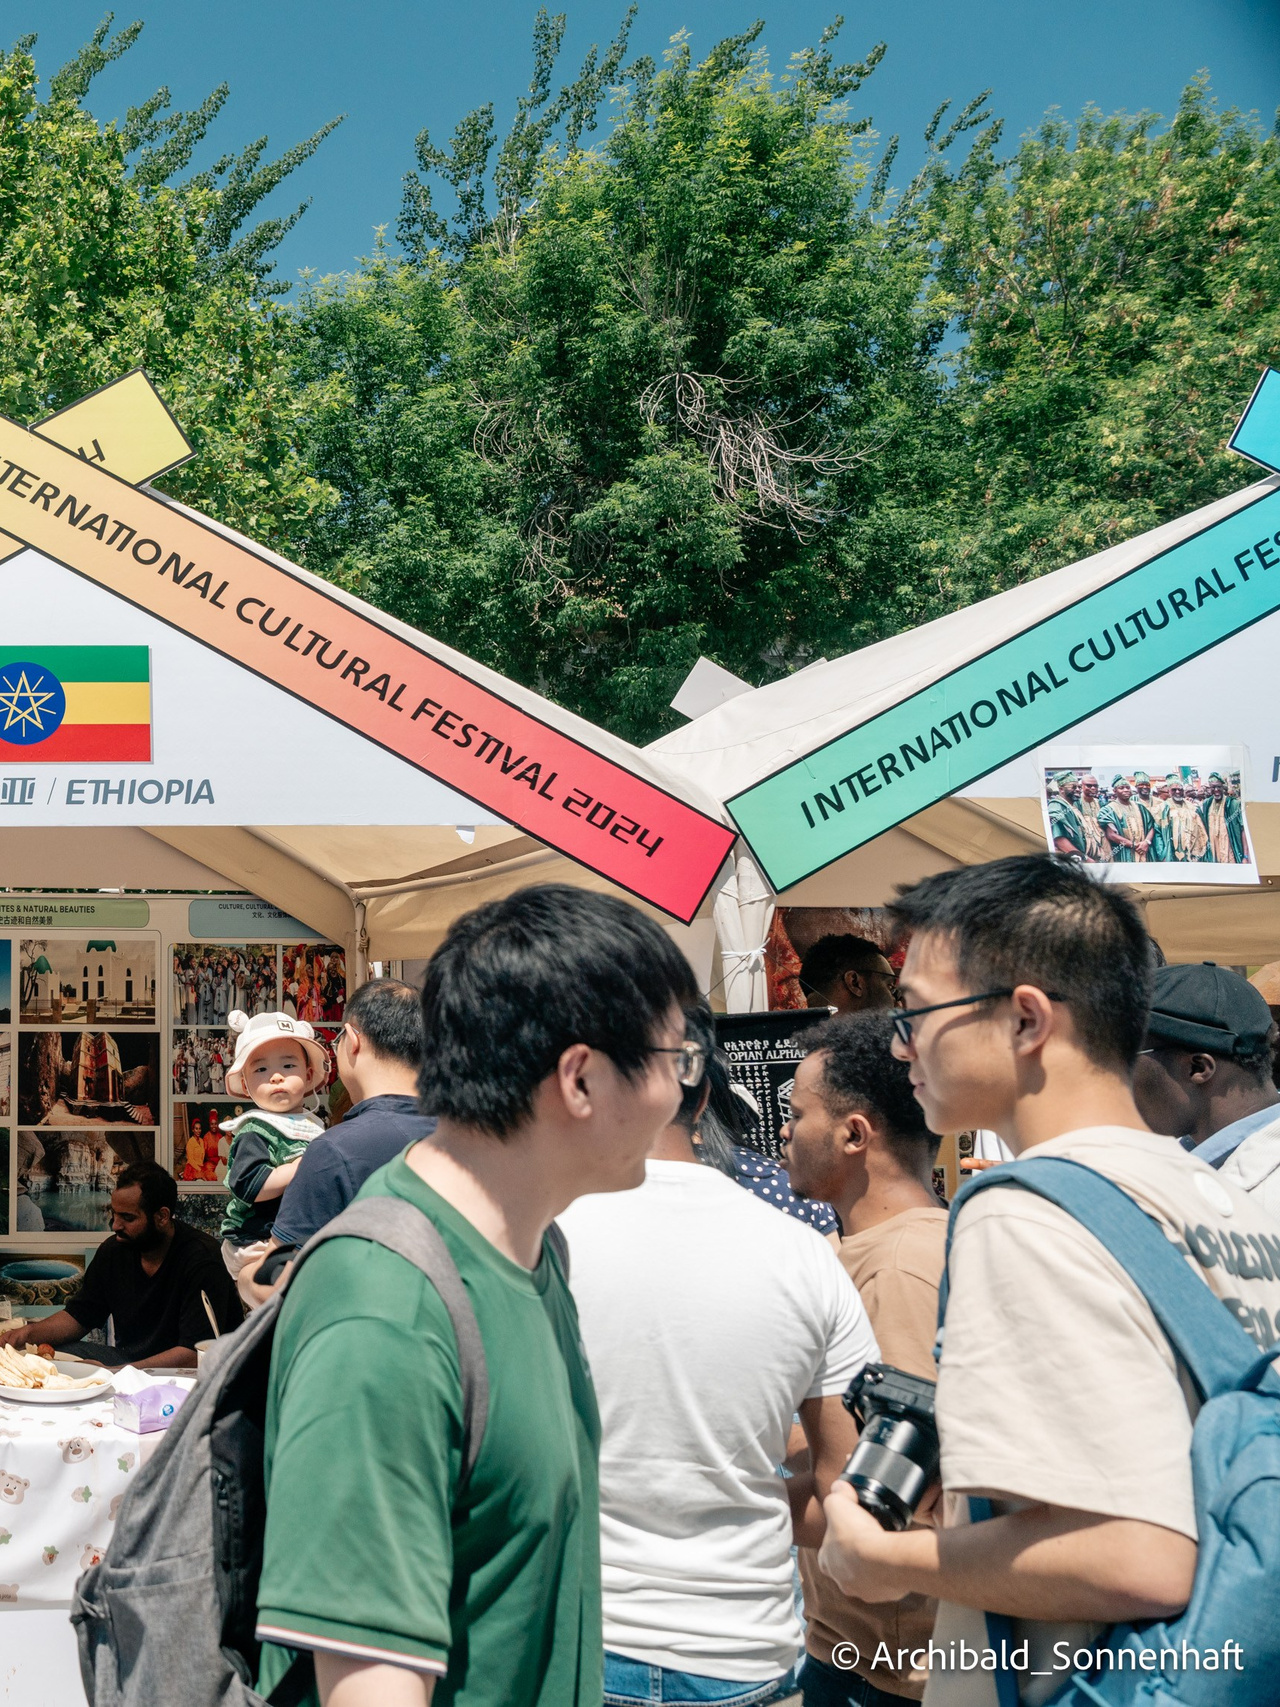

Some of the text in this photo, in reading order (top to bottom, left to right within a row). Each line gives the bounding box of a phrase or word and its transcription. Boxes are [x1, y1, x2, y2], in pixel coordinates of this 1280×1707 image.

[800, 531, 1280, 829] INTERNATIONAL CULTURAL FE
[237, 598, 407, 713] CULTURAL
[411, 698, 559, 802] FESTIVAL
[562, 788, 665, 858] 2024
[65, 779, 216, 806] ETHIOPIA
[16, 905, 21, 913] &
[23, 905, 58, 913] NATURAL
[59, 905, 96, 913] BEAUTIES
[726, 1050, 763, 1062] OPIAN
